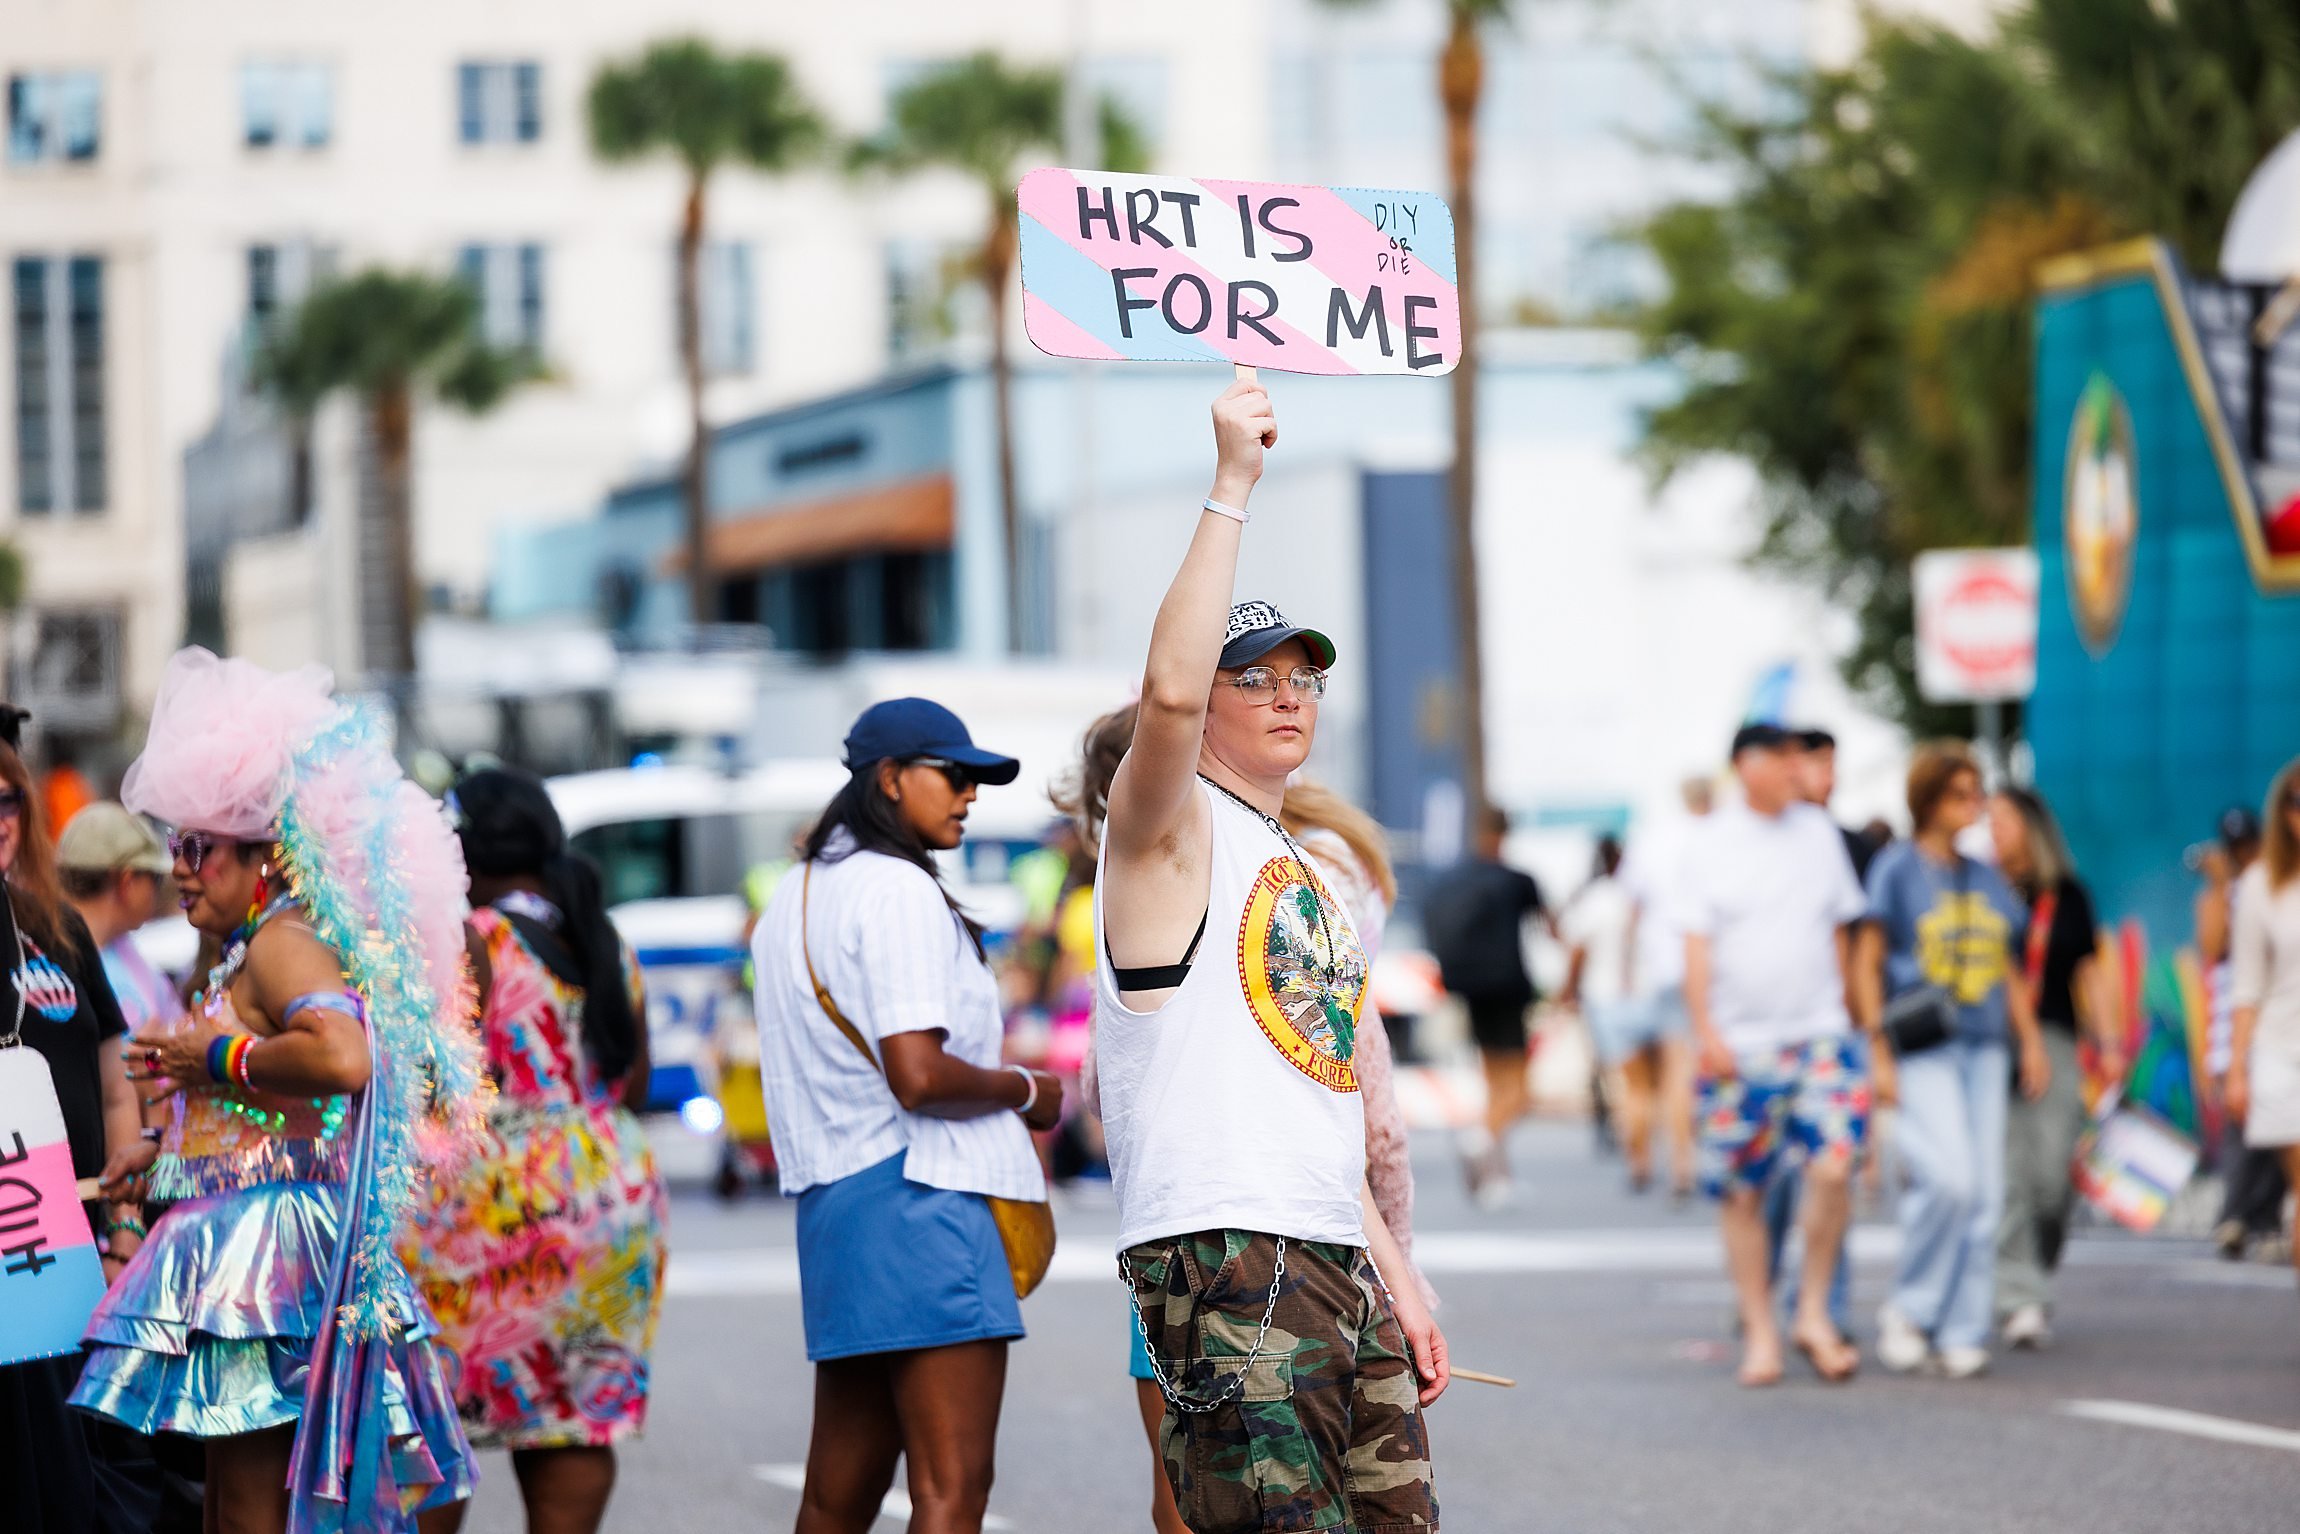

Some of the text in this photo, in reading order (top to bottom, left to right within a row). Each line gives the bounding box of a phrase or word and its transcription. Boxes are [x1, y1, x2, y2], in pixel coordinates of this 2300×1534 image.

[1076, 186, 1313, 263] HRT IS
[1375, 202, 1418, 235] DIY
[1389, 236, 1413, 256] OR
[1377, 253, 1411, 275] DIE
[1111, 268, 1443, 370] FOR ME
